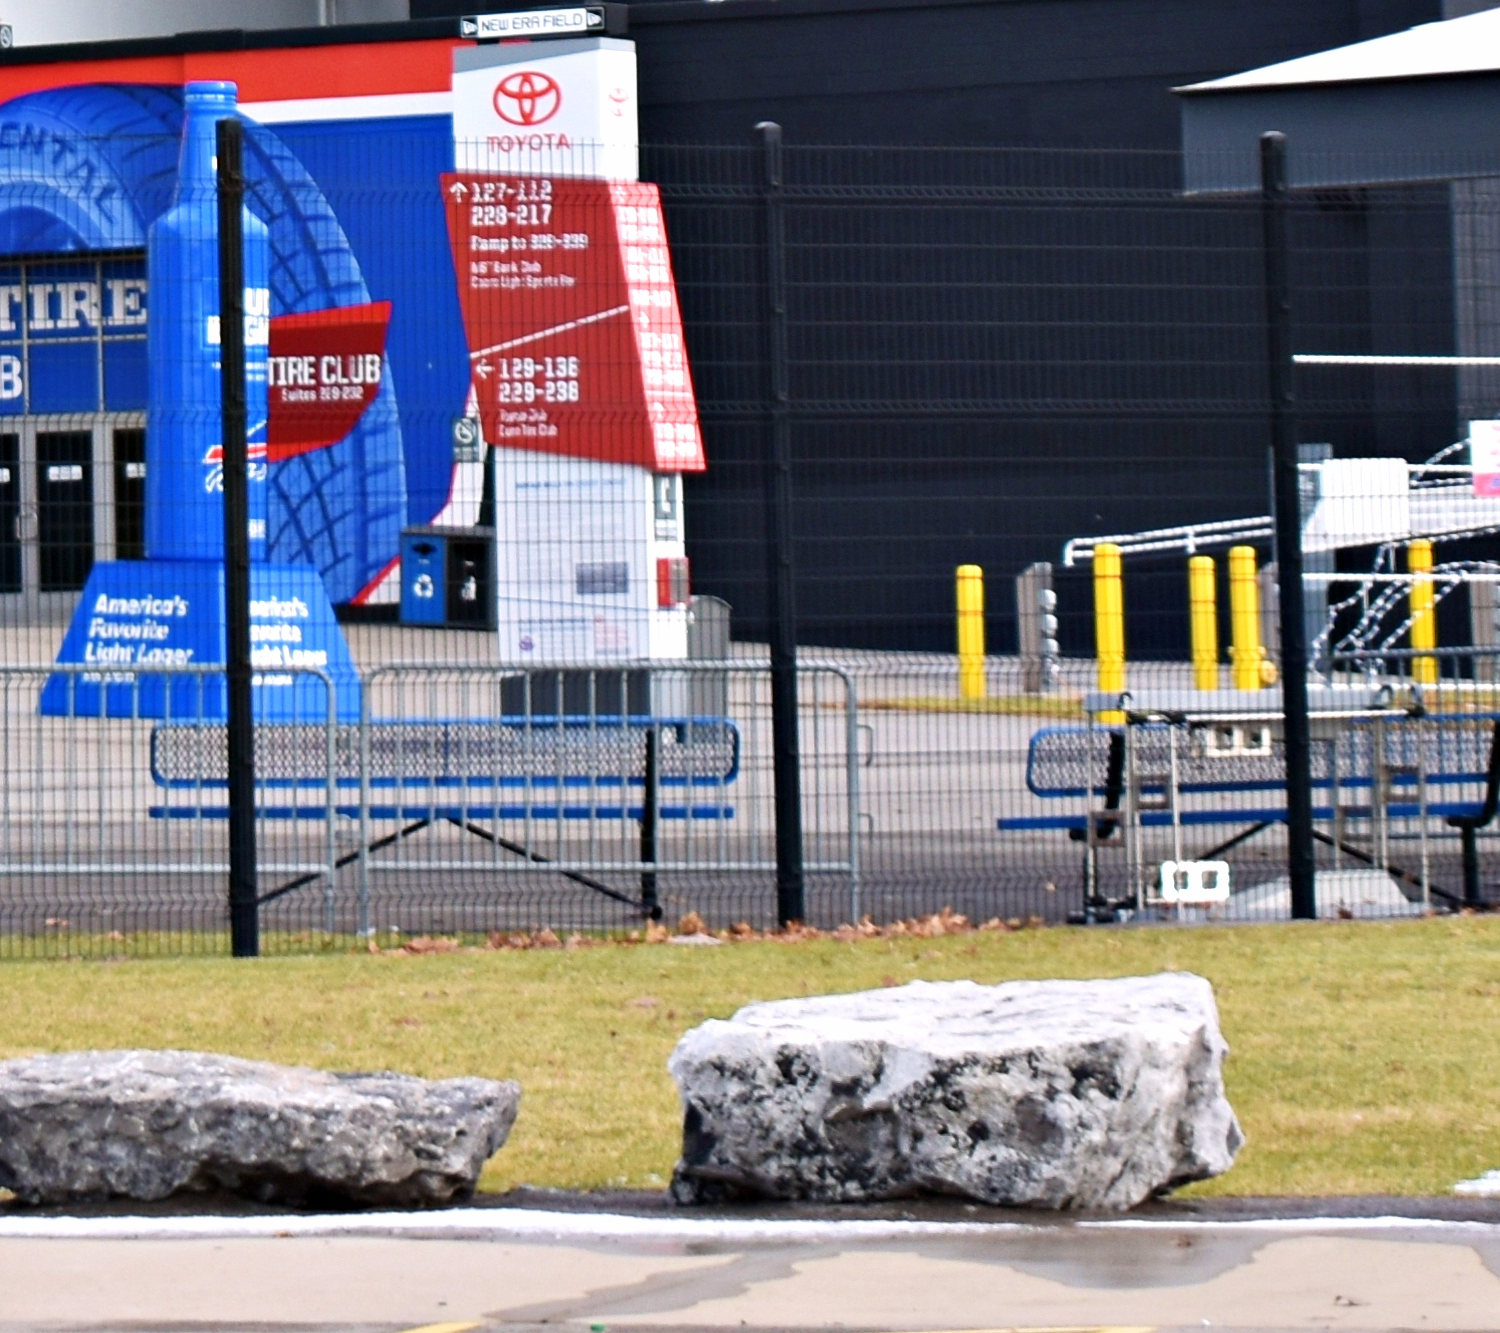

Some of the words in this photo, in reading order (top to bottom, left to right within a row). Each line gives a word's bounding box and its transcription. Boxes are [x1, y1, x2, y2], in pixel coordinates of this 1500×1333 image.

[481, 18, 509, 32] NEW
[511, 15, 540, 30] ERA
[543, 13, 584, 29] FIELD
[487, 133, 571, 154] TOYOTA
[512, 236, 527, 251] to
[269, 355, 317, 385] TIRE
[321, 354, 382, 384] CLUB
[281, 389, 317, 402] Suites
[94, 593, 188, 617] America's
[88, 617, 169, 641] Favorite
[85, 642, 135, 664] Light
